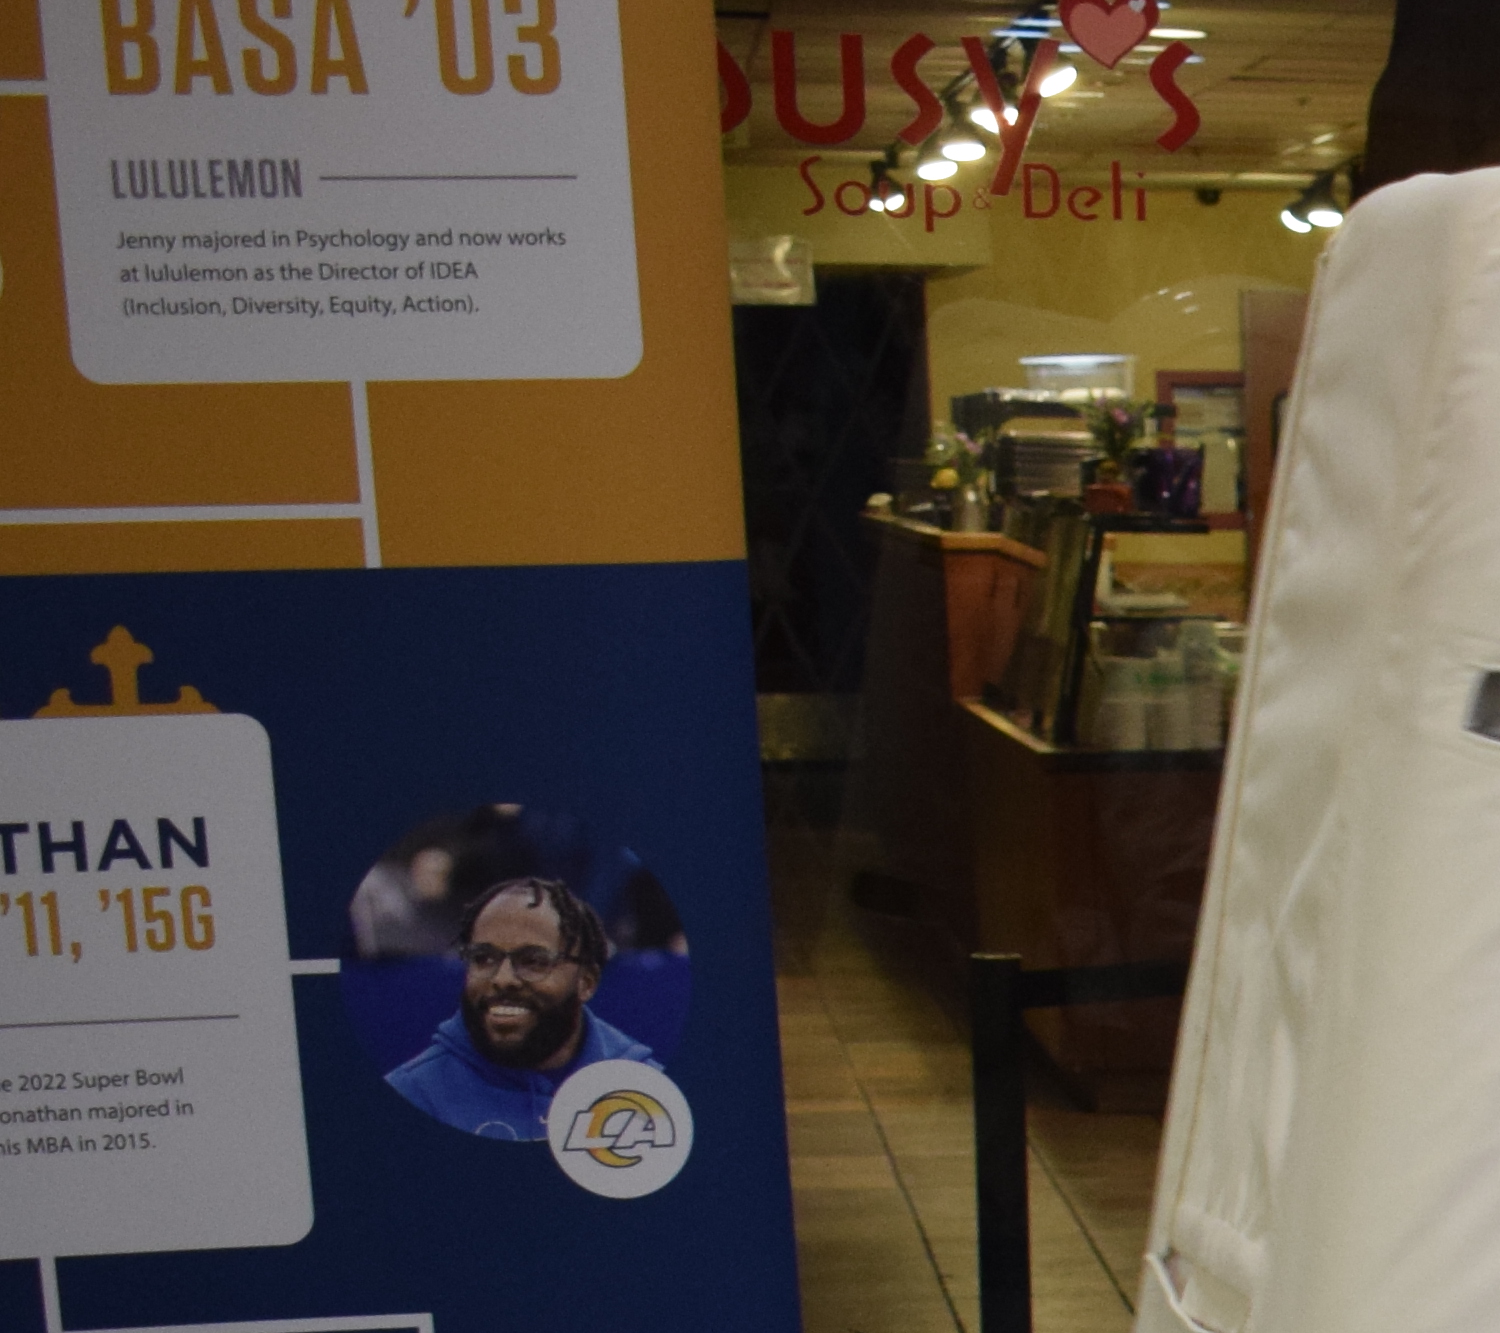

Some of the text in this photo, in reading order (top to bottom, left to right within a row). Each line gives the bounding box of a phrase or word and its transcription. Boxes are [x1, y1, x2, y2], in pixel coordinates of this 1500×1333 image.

[100, 0, 370, 97] BASA
[110, 158, 303, 199] LULULEMON
[800, 156, 1148, 232] Soup Deli
[116, 227, 567, 253] Jenny majored in Psychology and now works
[120, 261, 479, 283] at lululemon as the Director of IDEA
[123, 294, 480, 319] (Inclusion, Diversity, Equity, Action).
[98, 885, 216, 952] '15G
[19, 1067, 184, 1092] 2022 Super Bowl
[88, 1100, 170, 1124] majored
[176, 1100, 193, 1116] in
[27, 1133, 157, 1155] MBA in 2015.
